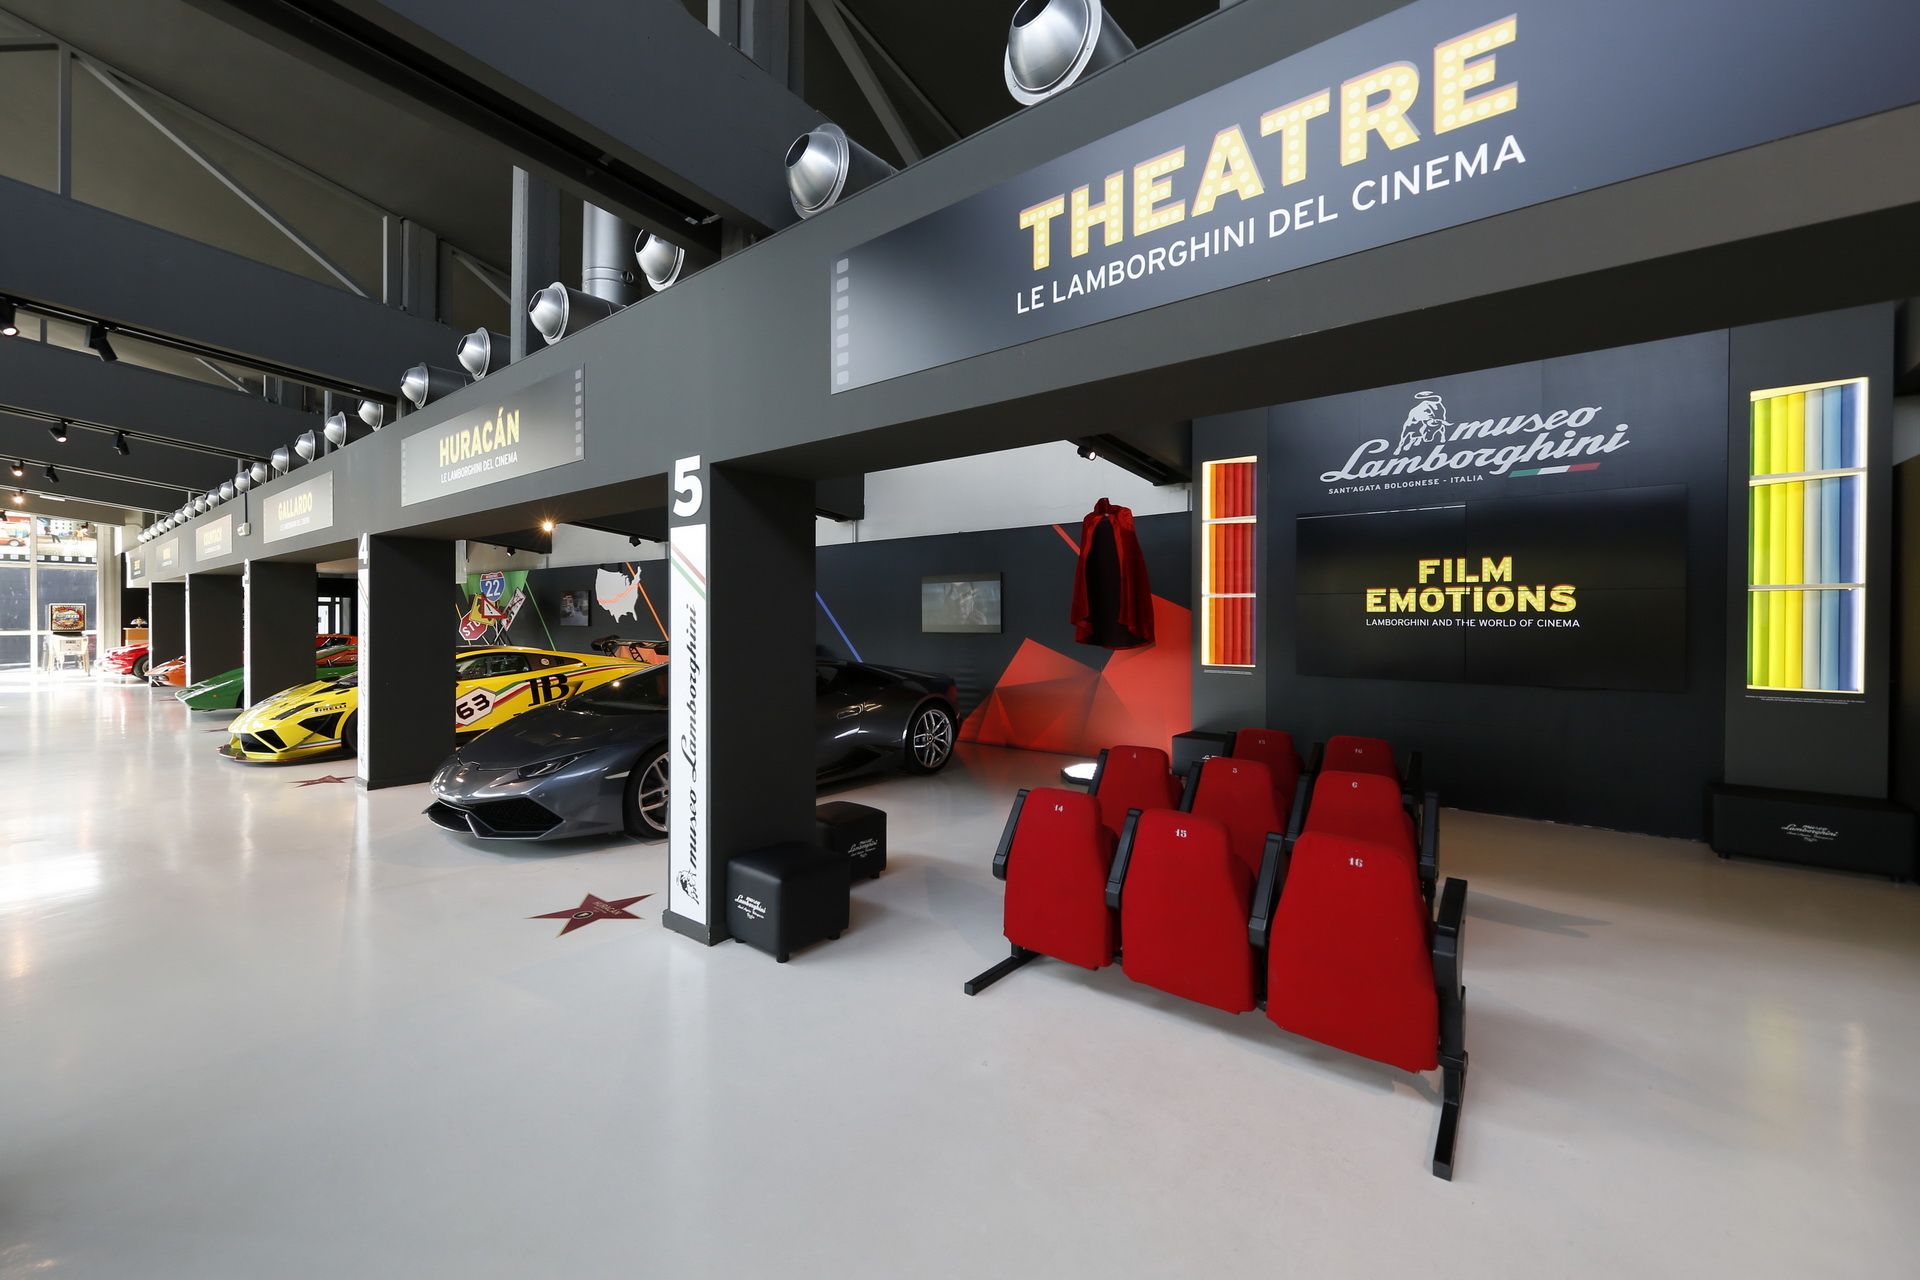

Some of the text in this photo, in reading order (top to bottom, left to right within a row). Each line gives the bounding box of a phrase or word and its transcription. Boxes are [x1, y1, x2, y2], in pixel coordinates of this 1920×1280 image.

[1018, 13, 1519, 271] THEATRE
[1017, 134, 1526, 315] LE LAMBORGHINI DEL CINEMA
[439, 406, 520, 467] HURACÁN
[1448, 406, 1602, 441] museo
[440, 451, 518, 484] LE LAMBORGHINI DEL CINEMA
[1320, 423, 1630, 483] Lamborghini
[672, 455, 703, 517] 5
[1328, 484, 1381, 494] SANT'AGATA
[1384, 478, 1440, 490] BOLOGNESE
[1450, 474, 1483, 483] ITALIA
[278, 491, 313, 521] GALLARDO
[359, 532, 369, 565] 4
[1418, 556, 1513, 584] FILM
[485, 579, 500, 597] 22
[1365, 584, 1577, 613] EMOTIONS
[1366, 618, 1580, 627] LAMBORGHINI AND THE WORLD OF CINEMA
[456, 693, 490, 720] 63
[681, 603, 701, 783] Lamborghini
[1054, 804, 1064, 812] 14
[689, 786, 697, 870] museo
[1174, 829, 1187, 838] 15
[1348, 857, 1363, 868] 16
